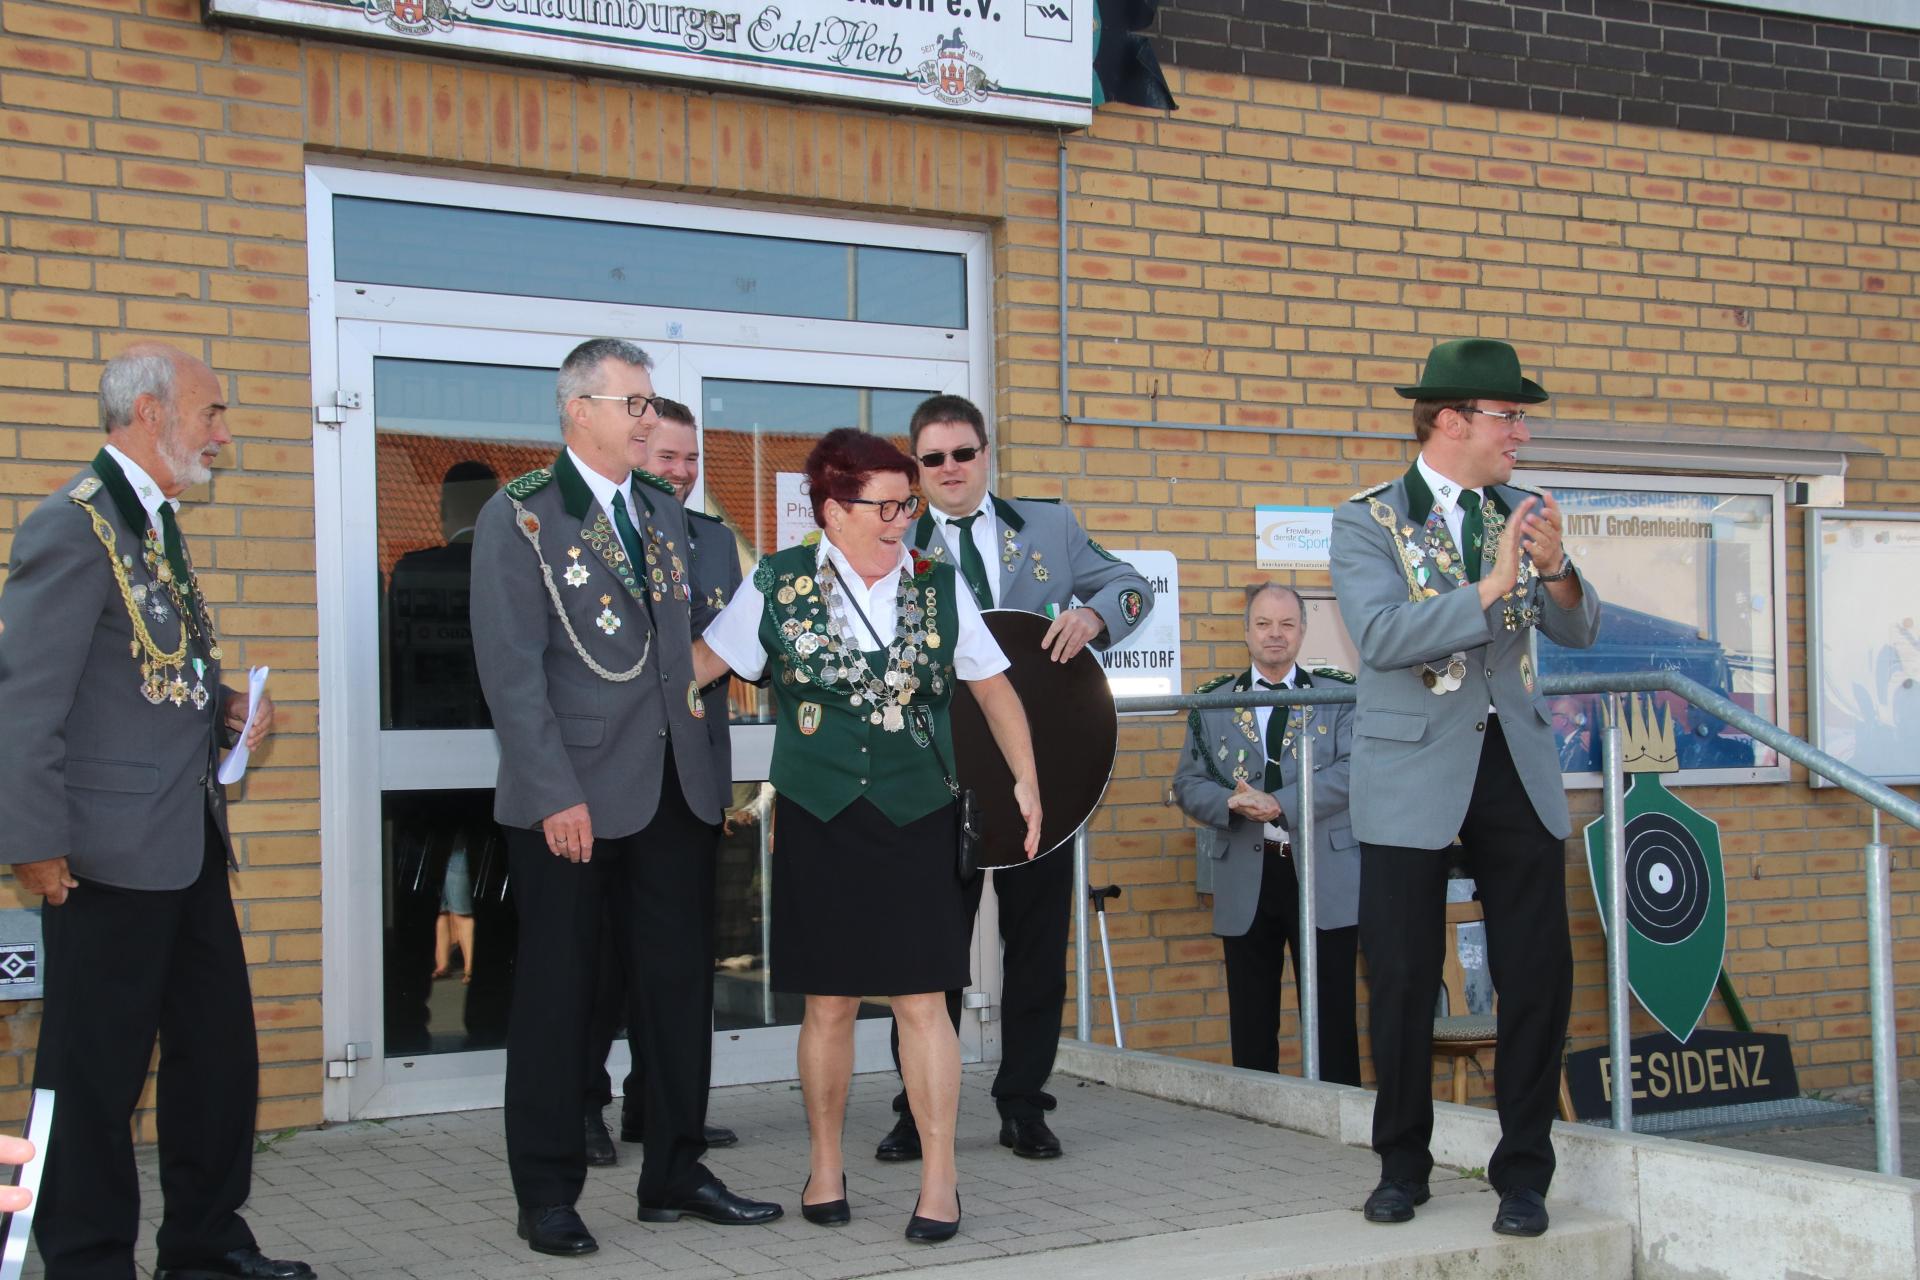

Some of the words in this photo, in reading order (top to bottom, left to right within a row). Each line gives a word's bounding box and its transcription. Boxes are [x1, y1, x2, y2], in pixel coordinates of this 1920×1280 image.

[471, 0, 741, 50] aumburger
[747, 5, 903, 66] Edel-Herb
[920, 43, 936, 54] SEIT
[968, 49, 984, 61] 1873
[1589, 491, 1719, 510] GROSSENHEIDORN
[1567, 514, 1601, 536] MTV
[1606, 515, 1713, 539] Großenheidorn
[1298, 536, 1329, 551] Sport
[1146, 576, 1169, 594] cht
[1102, 650, 1175, 669] WUNSTORF
